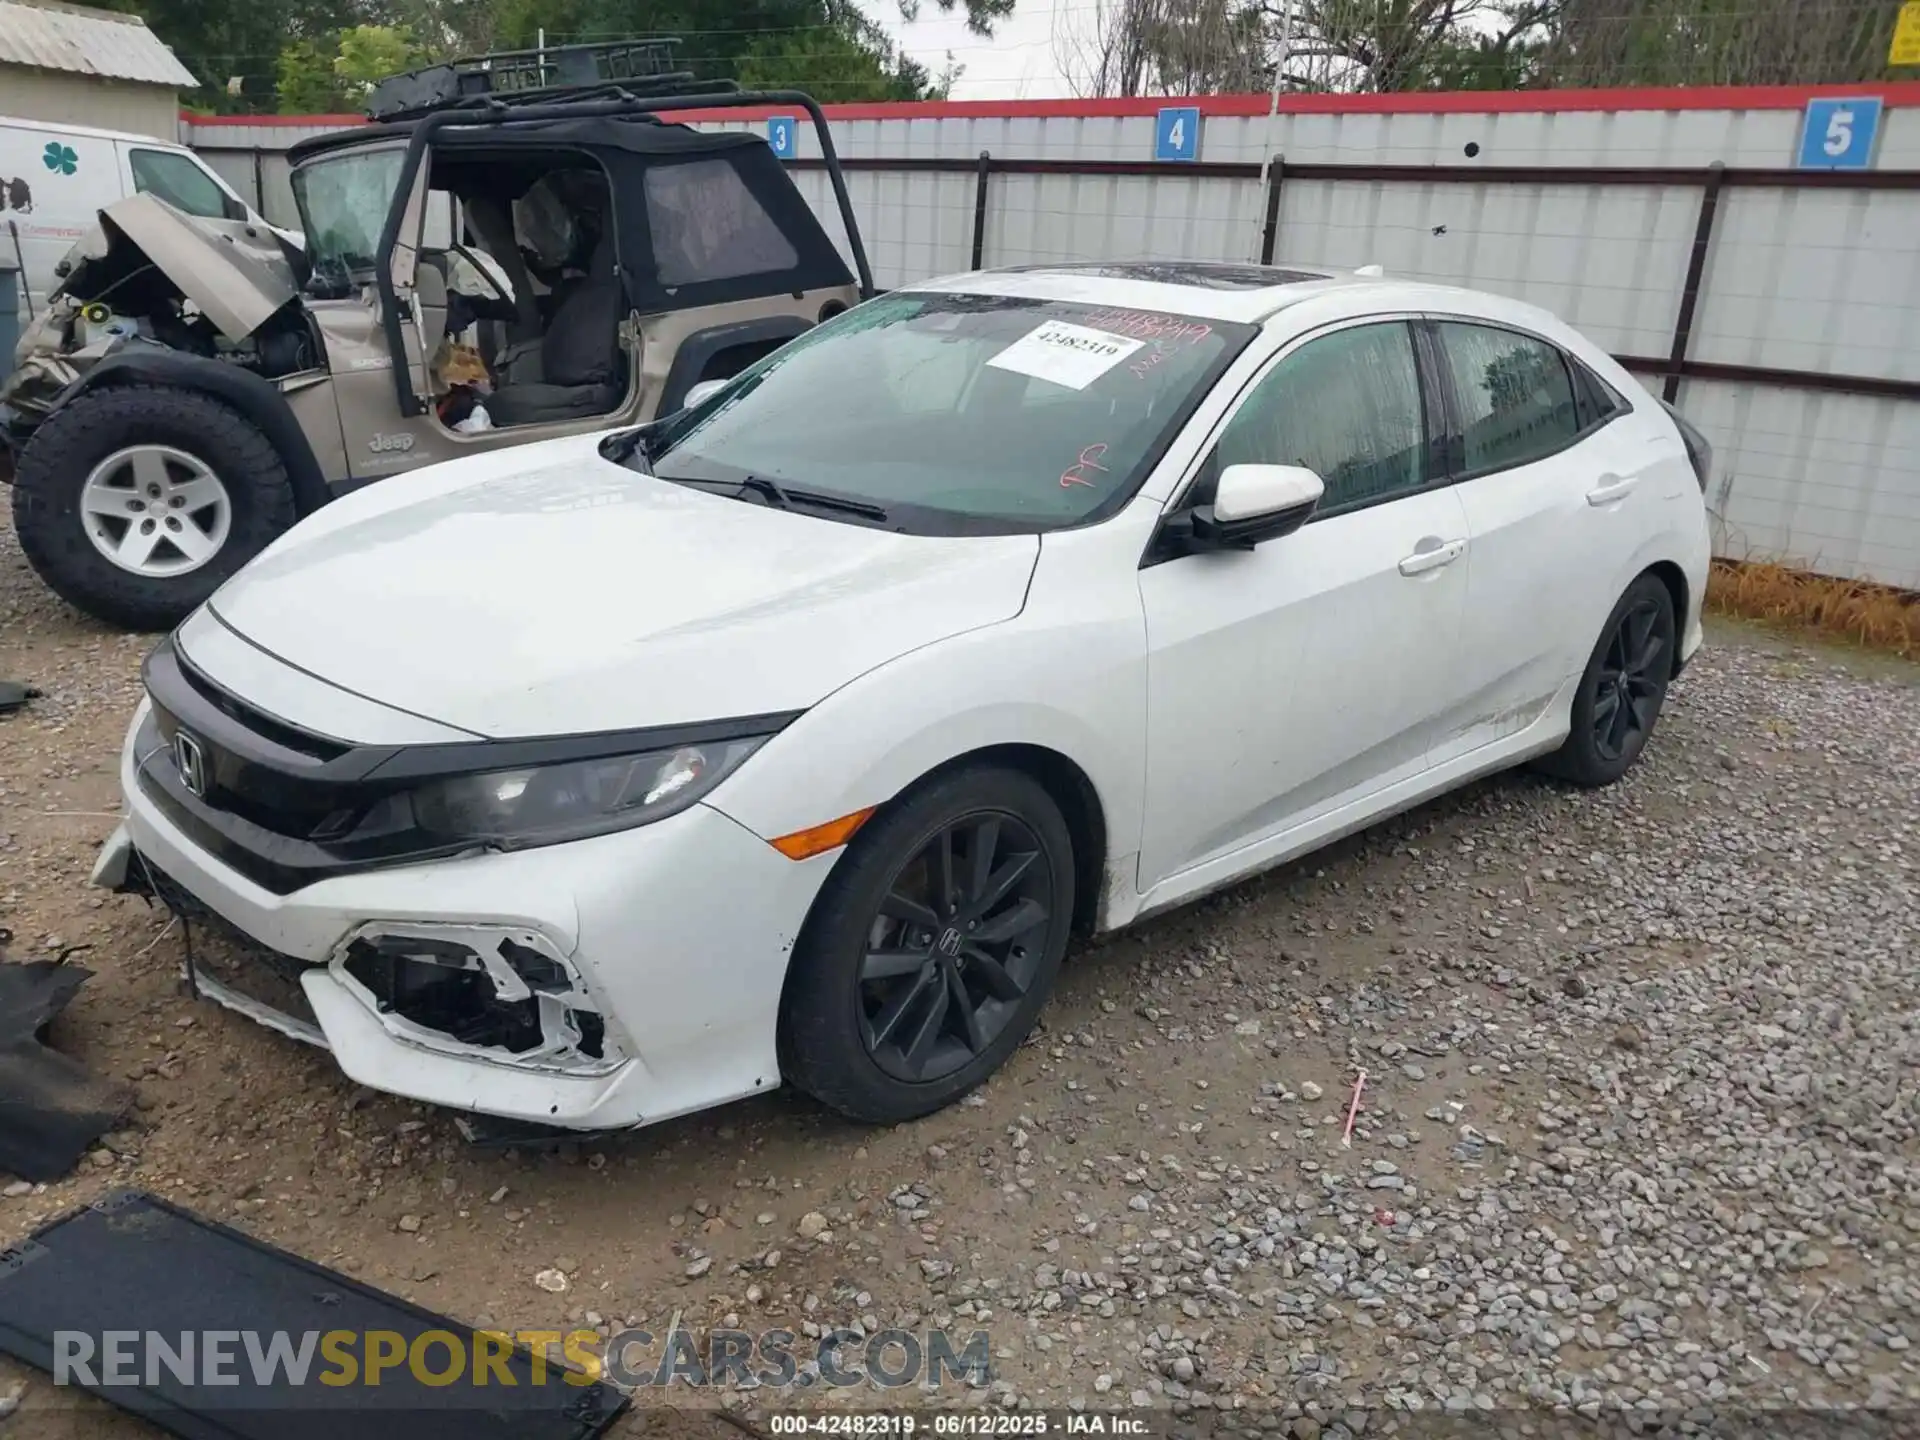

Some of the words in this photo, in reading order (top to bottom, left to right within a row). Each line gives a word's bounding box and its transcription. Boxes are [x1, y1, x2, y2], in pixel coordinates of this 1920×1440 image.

[776, 125, 786, 151] 3
[1168, 118, 1184, 150] 4
[1823, 111, 1854, 156] 5
[1038, 331, 1119, 356] 42482319
[368, 433, 418, 452] Jeep
